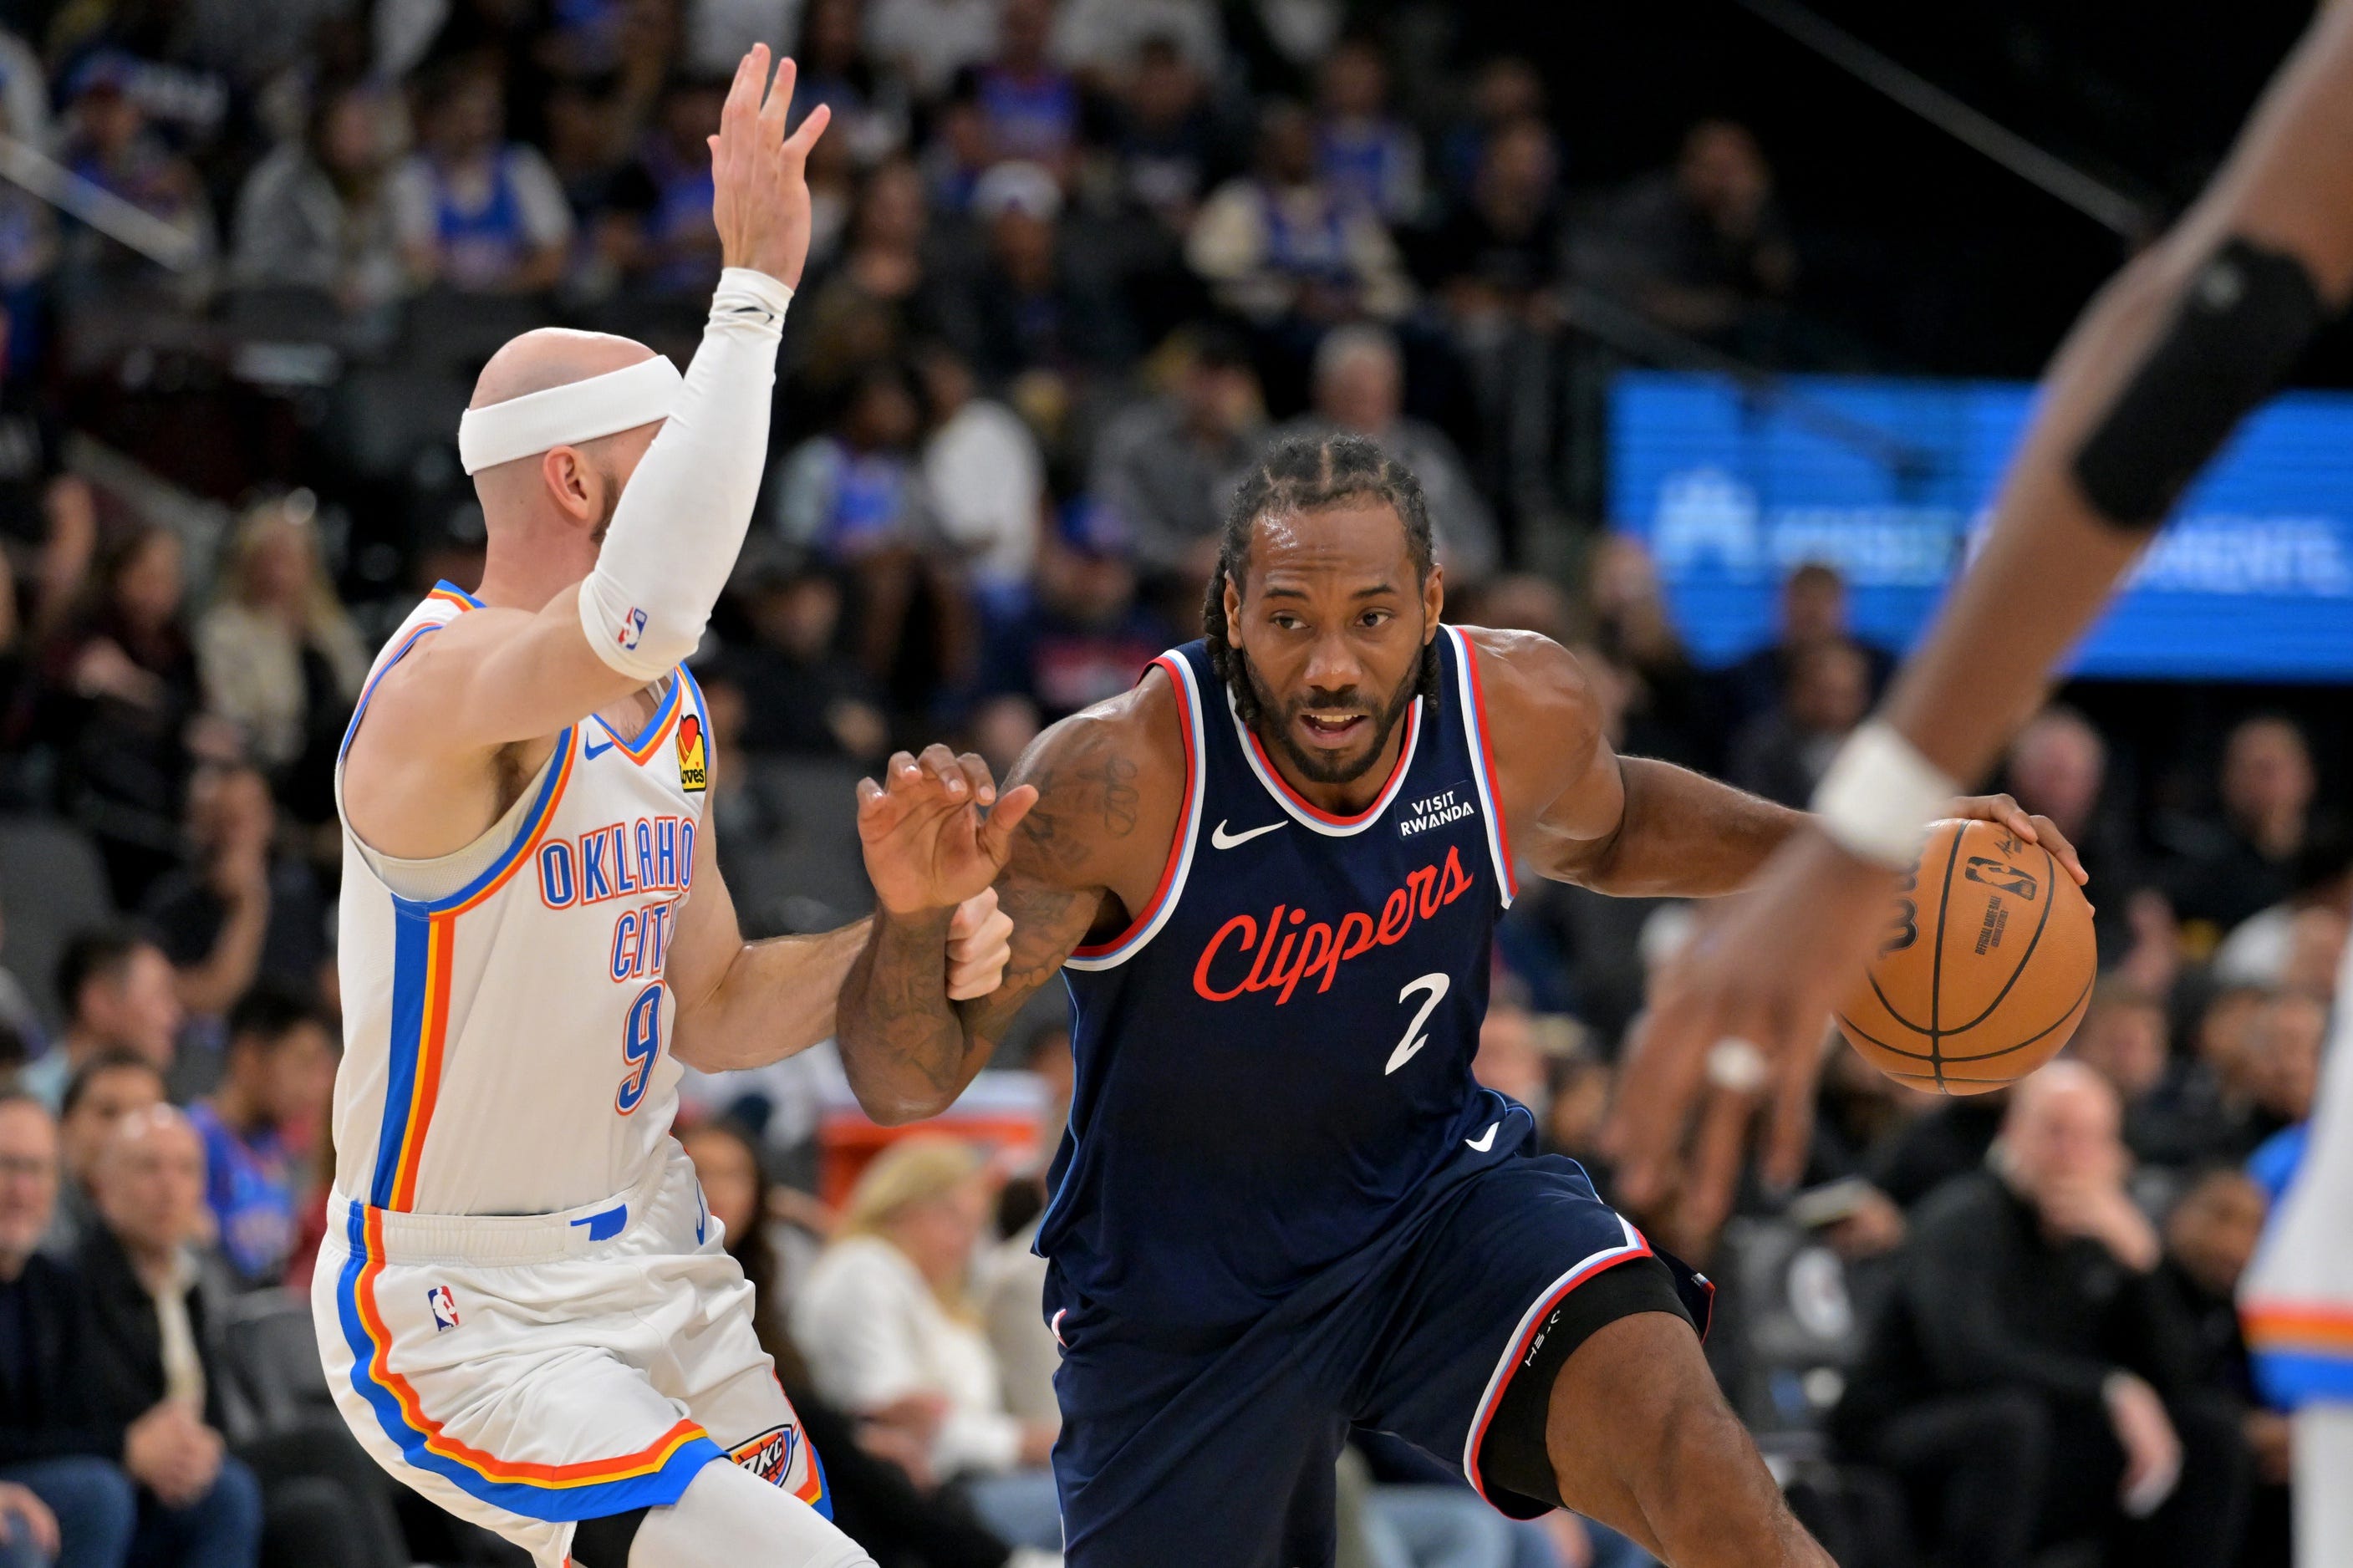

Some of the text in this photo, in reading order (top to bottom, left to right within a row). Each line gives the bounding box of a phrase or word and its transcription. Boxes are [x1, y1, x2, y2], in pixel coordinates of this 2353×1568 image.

[1400, 802, 1474, 837] RWANDA
[1411, 790, 1454, 816] VISIT
[1193, 845, 1474, 1006] Clippers
[614, 979, 666, 1117] 9
[1384, 972, 1450, 1076] 2
